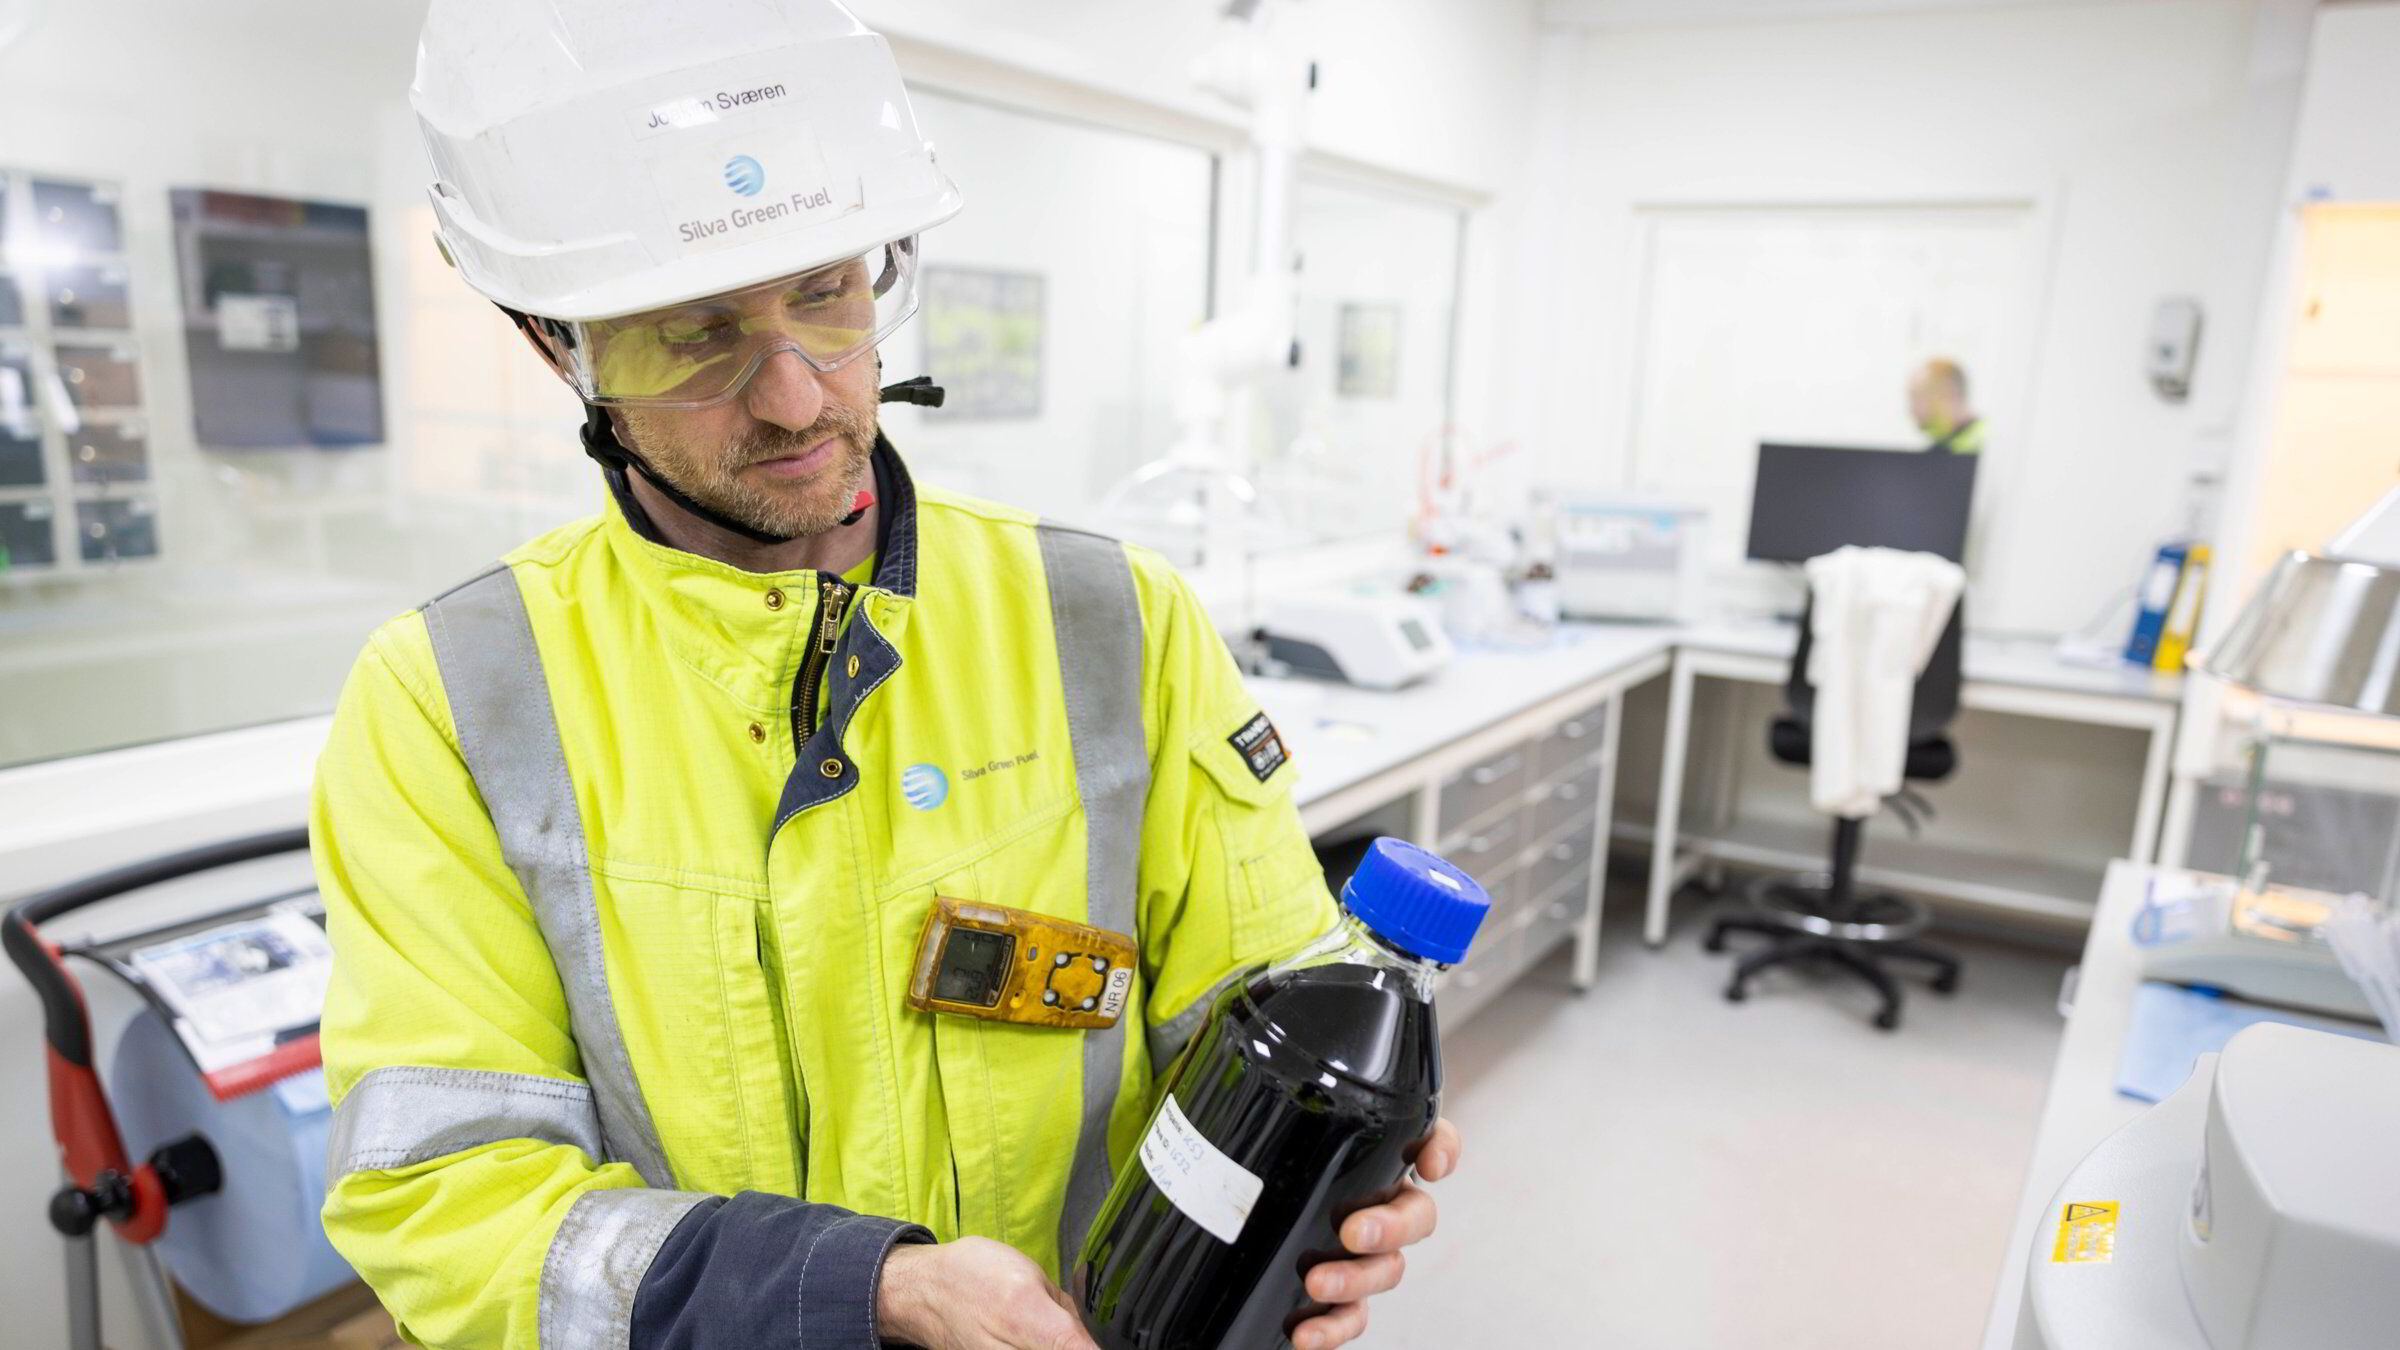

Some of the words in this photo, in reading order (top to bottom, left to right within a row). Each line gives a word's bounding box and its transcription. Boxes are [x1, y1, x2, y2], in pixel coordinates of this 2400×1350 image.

[716, 83, 787, 110] Sværen
[679, 219, 728, 243] Silva
[731, 202, 789, 229] Green
[791, 187, 832, 213] Fuel
[961, 767, 987, 781] Silva
[988, 760, 1014, 772] Green
[1015, 749, 1039, 766] Fuel
[1112, 971, 1128, 988] 06
[1104, 992, 1121, 1013] NR
